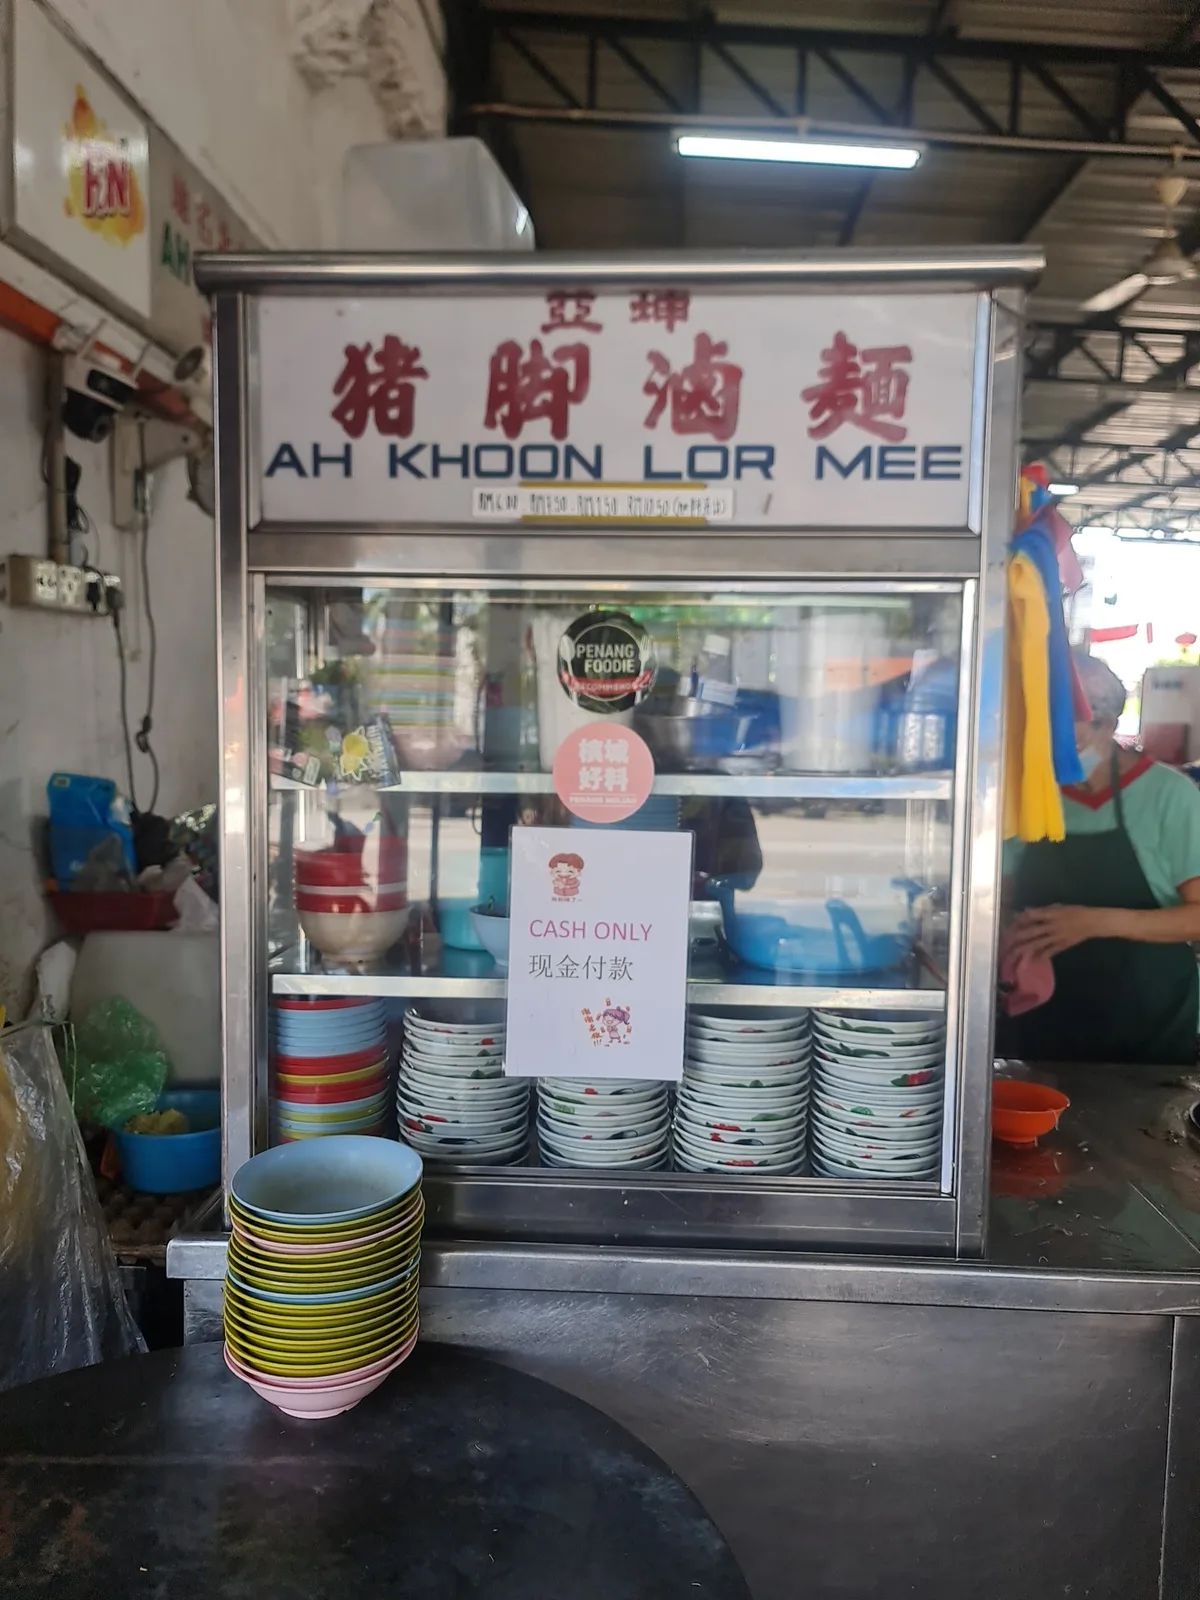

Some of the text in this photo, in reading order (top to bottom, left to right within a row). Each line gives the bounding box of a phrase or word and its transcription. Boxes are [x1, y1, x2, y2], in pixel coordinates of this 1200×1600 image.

[265, 443, 962, 480] AH KHOON LOR MEE
[576, 643, 635, 659] PENANG
[584, 659, 635, 673] FOODIE
[529, 919, 653, 941] CASH ONLY
[528, 954, 634, 981] 现金付款
